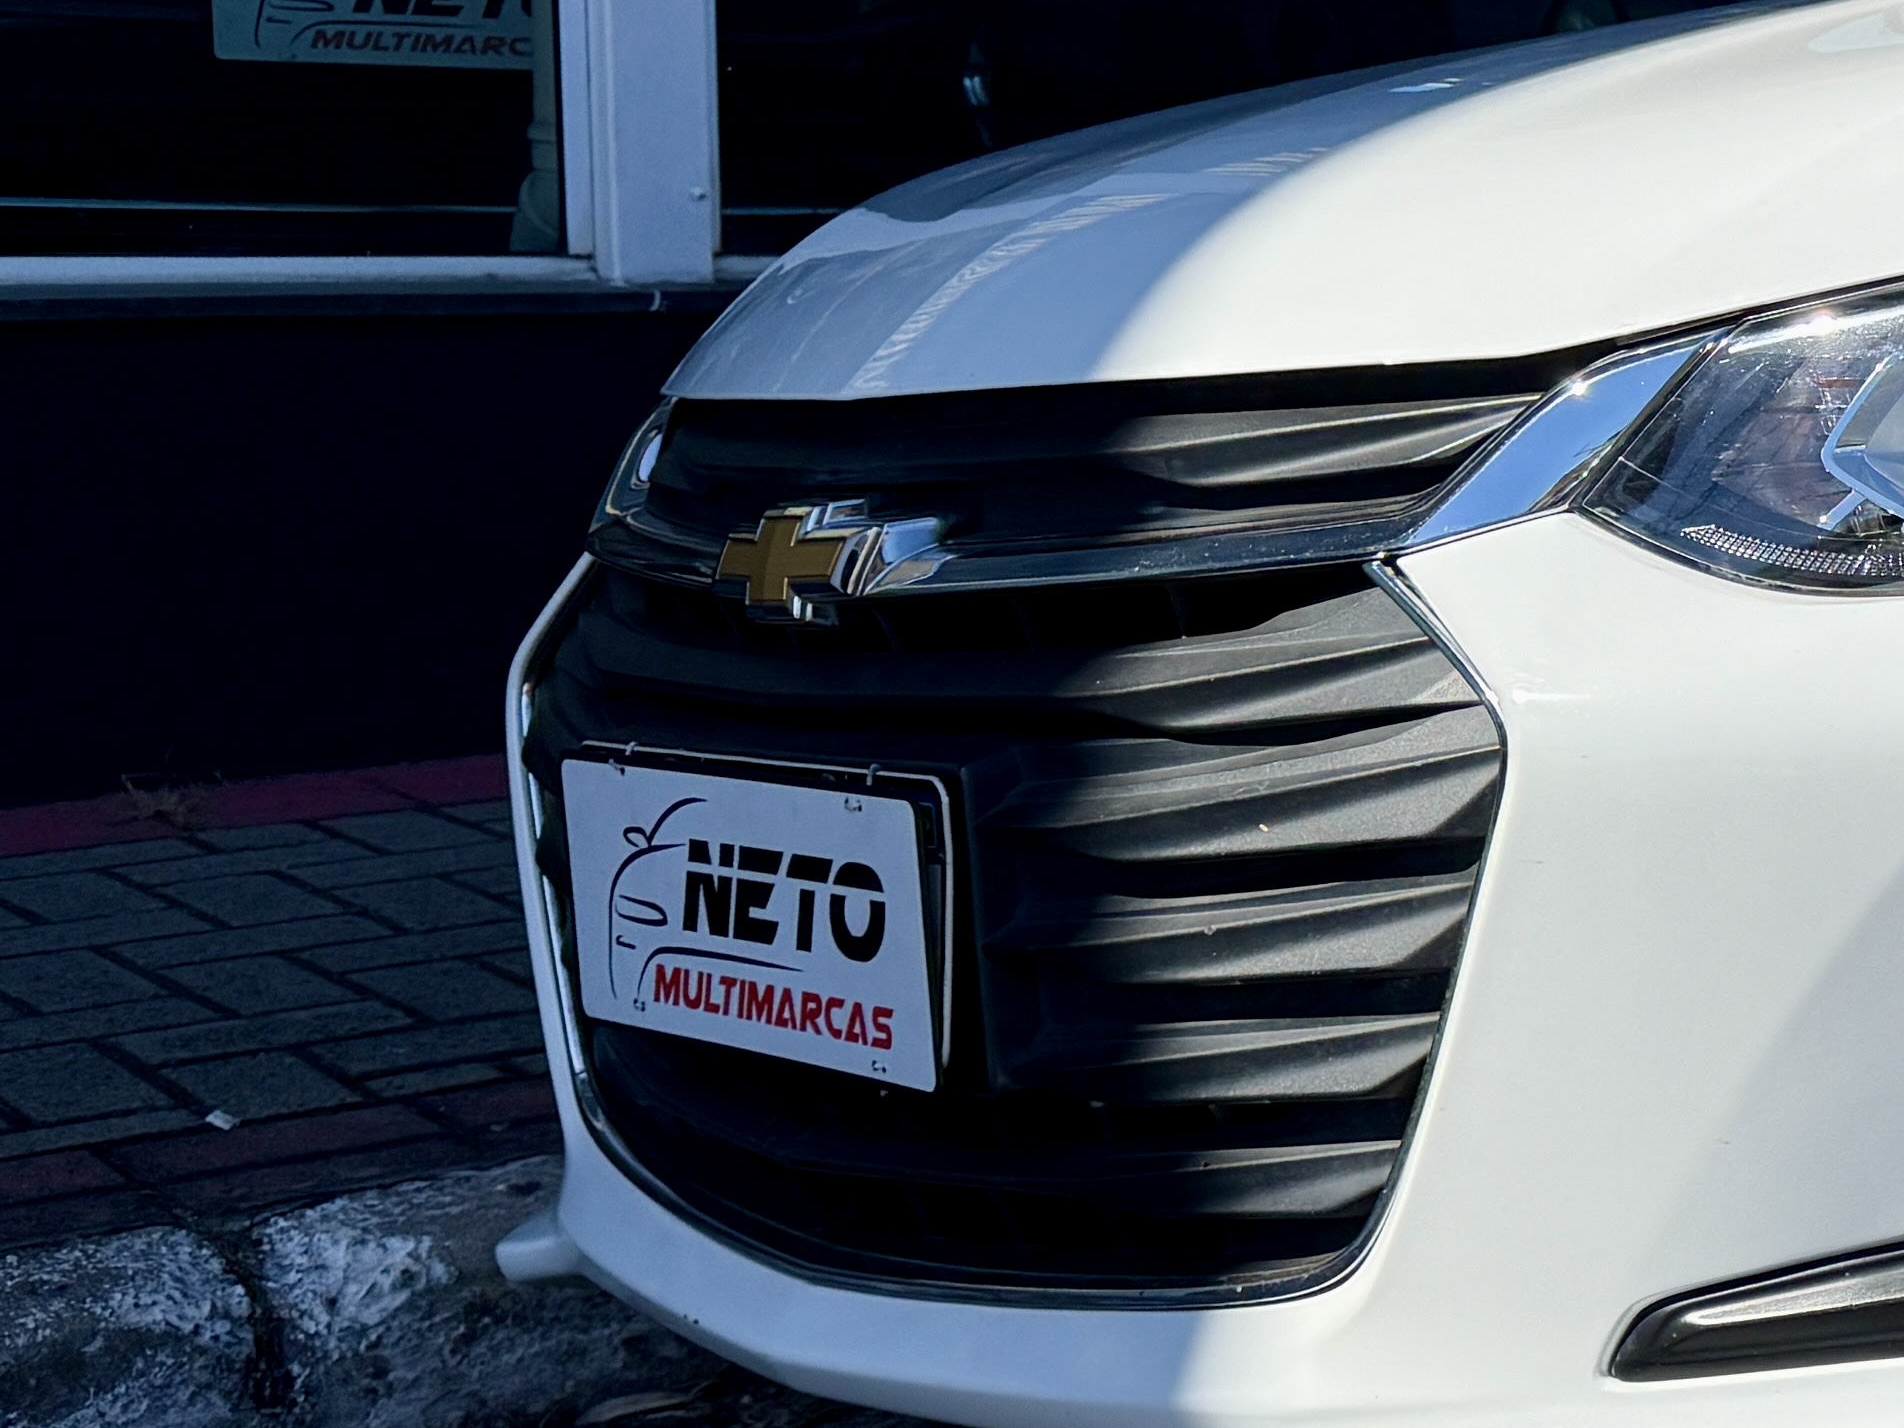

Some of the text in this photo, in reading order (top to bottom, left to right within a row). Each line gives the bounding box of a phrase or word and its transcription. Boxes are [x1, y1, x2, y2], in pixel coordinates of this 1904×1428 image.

[309, 28, 533, 58] MULTIMARC
[682, 838, 886, 963] NETO
[652, 963, 895, 1051] MULTIMARCAS
